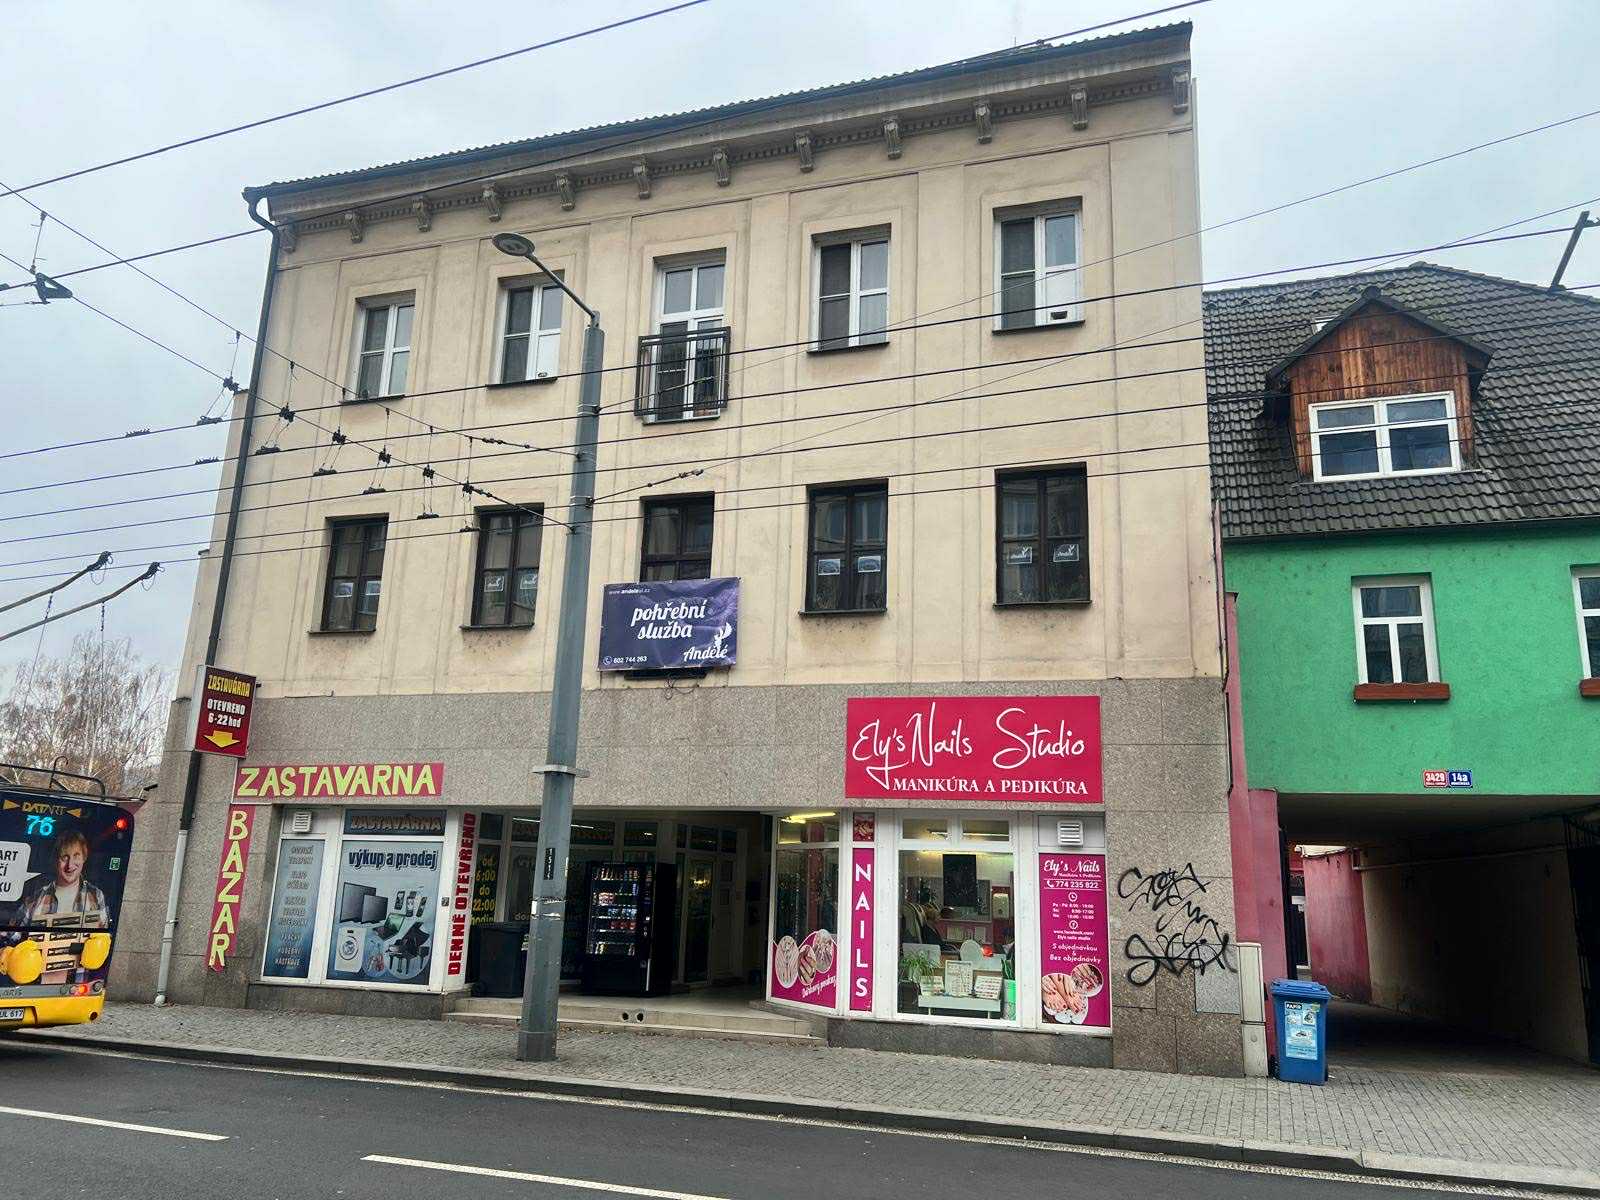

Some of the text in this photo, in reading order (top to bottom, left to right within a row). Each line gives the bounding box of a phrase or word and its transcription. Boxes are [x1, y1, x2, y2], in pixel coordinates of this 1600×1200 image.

[631, 600, 708, 627] pohřební
[637, 620, 693, 640] služba
[228, 715, 242, 728] hod
[852, 702, 1085, 789] Ely's Nails Studio
[237, 764, 437, 797] ZASTAVARNA
[893, 777, 1089, 795] MANIKÚRA A PEDIKÚRA
[1452, 773, 1468, 781] 14a
[26, 815, 57, 836] 76
[349, 849, 438, 871] výkup a prodej
[1043, 860, 1100, 876] Ely's Nails
[208, 810, 249, 967] BAZAR
[479, 886, 490, 896] do
[855, 864, 871, 997] NAILS
[448, 914, 466, 976] DENNĚ
[1063, 955, 1101, 964] objednávky
